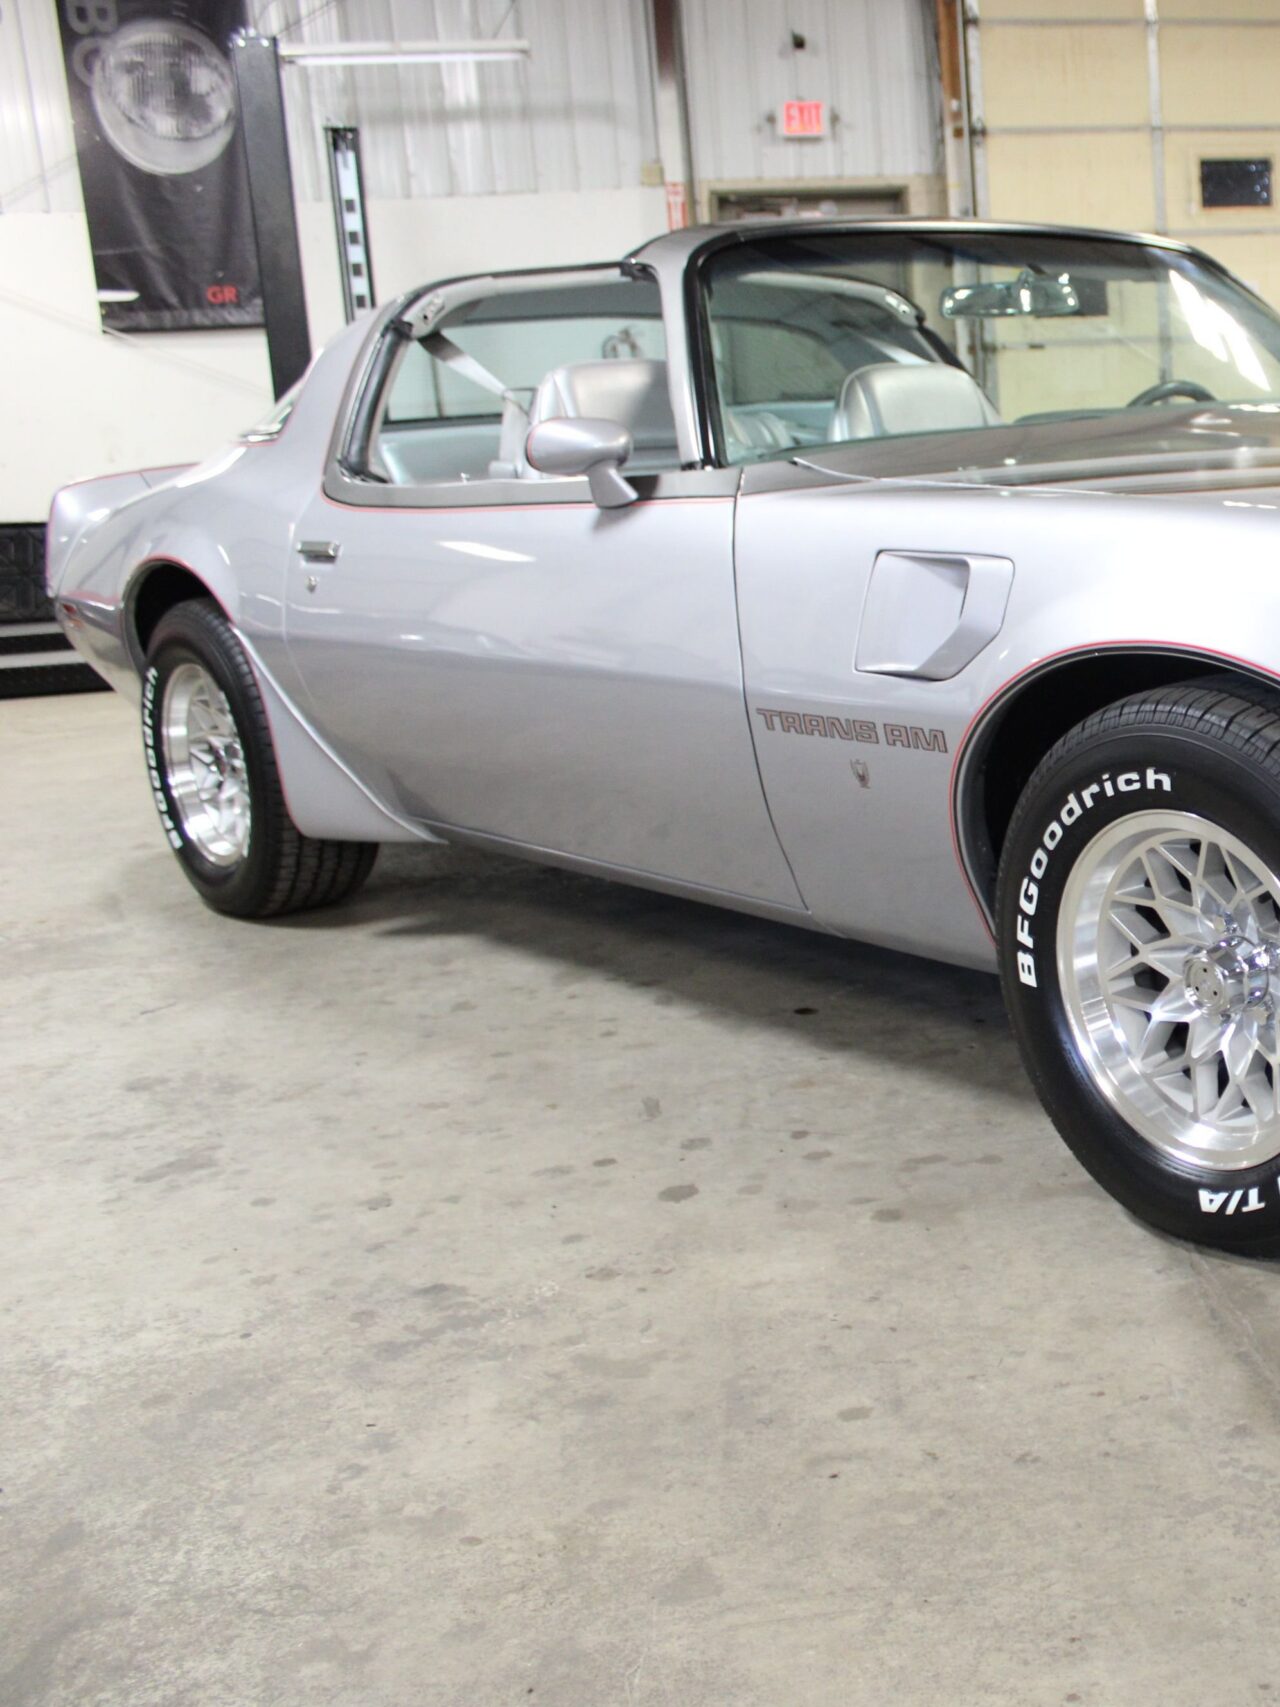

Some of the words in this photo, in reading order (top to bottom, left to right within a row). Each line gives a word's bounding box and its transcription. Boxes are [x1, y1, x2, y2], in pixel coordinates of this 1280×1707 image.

[785, 103, 822, 132] EXIT
[207, 285, 238, 304] GR
[756, 708, 879, 744] TRANS
[883, 723, 949, 753] AM
[1016, 768, 1172, 988] BFGoodrich
[1198, 1188, 1265, 1215] T/A
